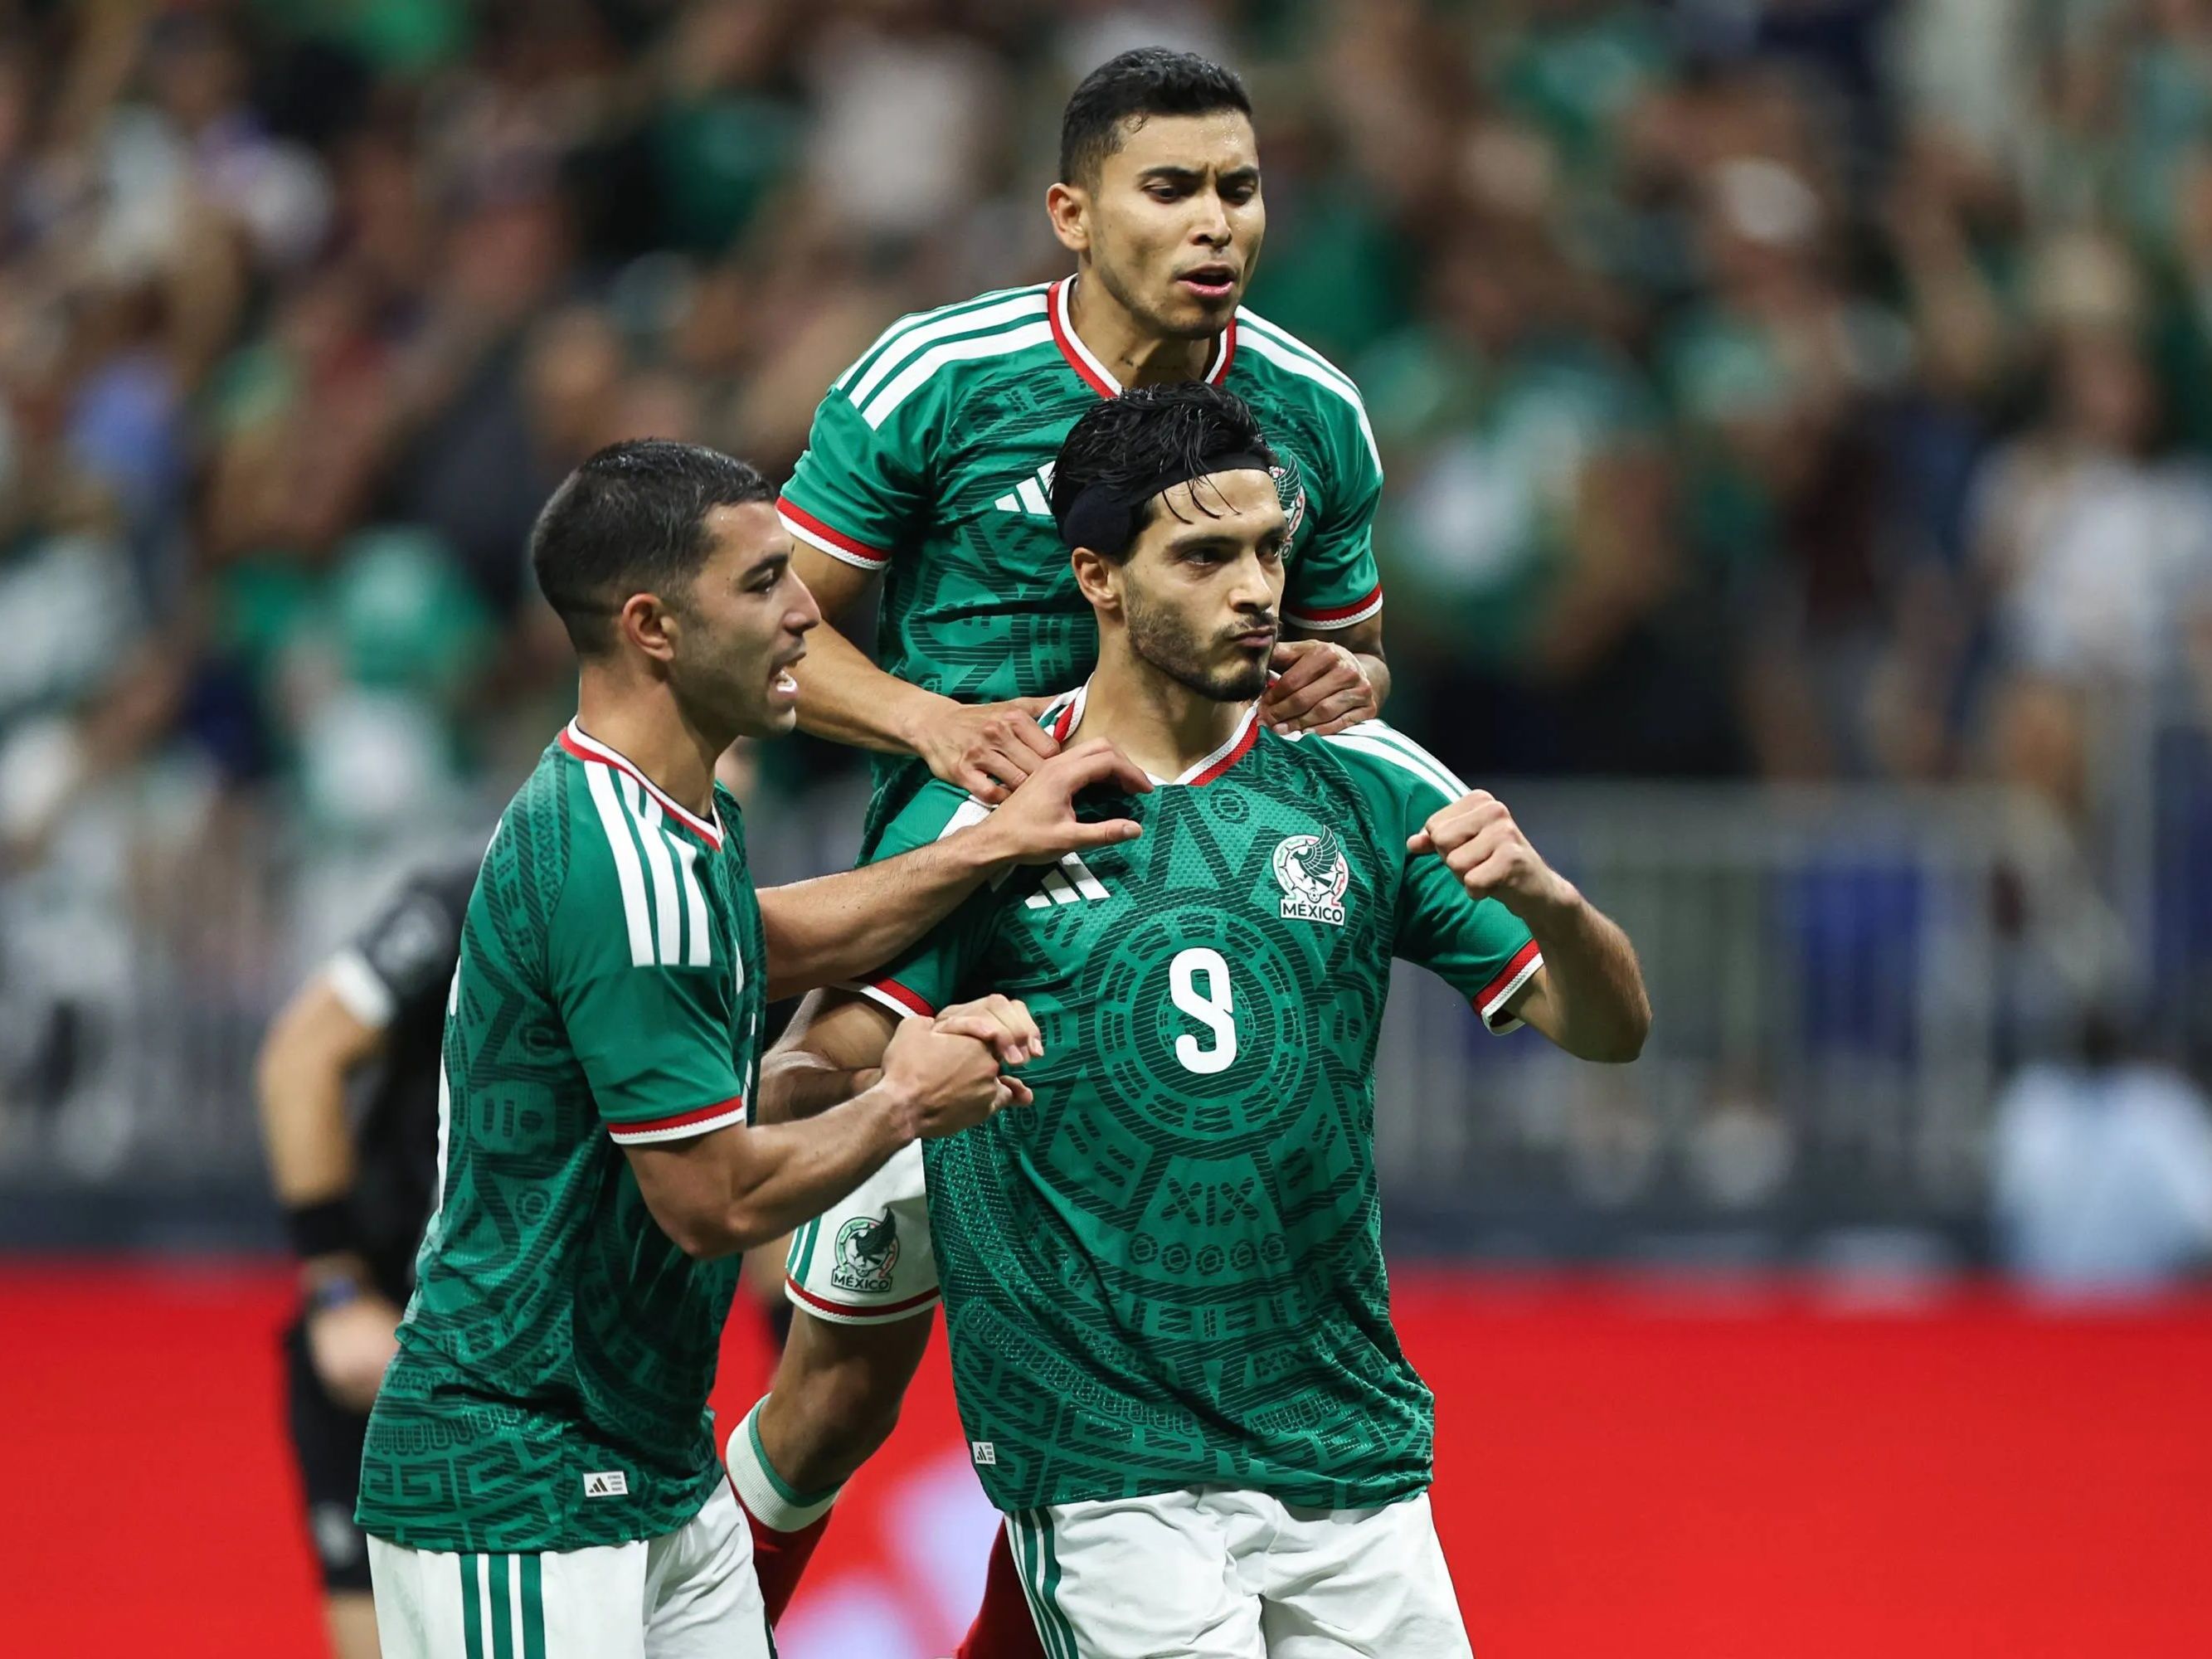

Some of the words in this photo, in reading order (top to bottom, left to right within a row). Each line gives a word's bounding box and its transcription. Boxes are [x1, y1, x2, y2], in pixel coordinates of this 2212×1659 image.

[1282, 901, 1343, 922] MÉXICO
[1169, 947, 1237, 1074] 9
[834, 1273, 889, 1290] MÉXICO
